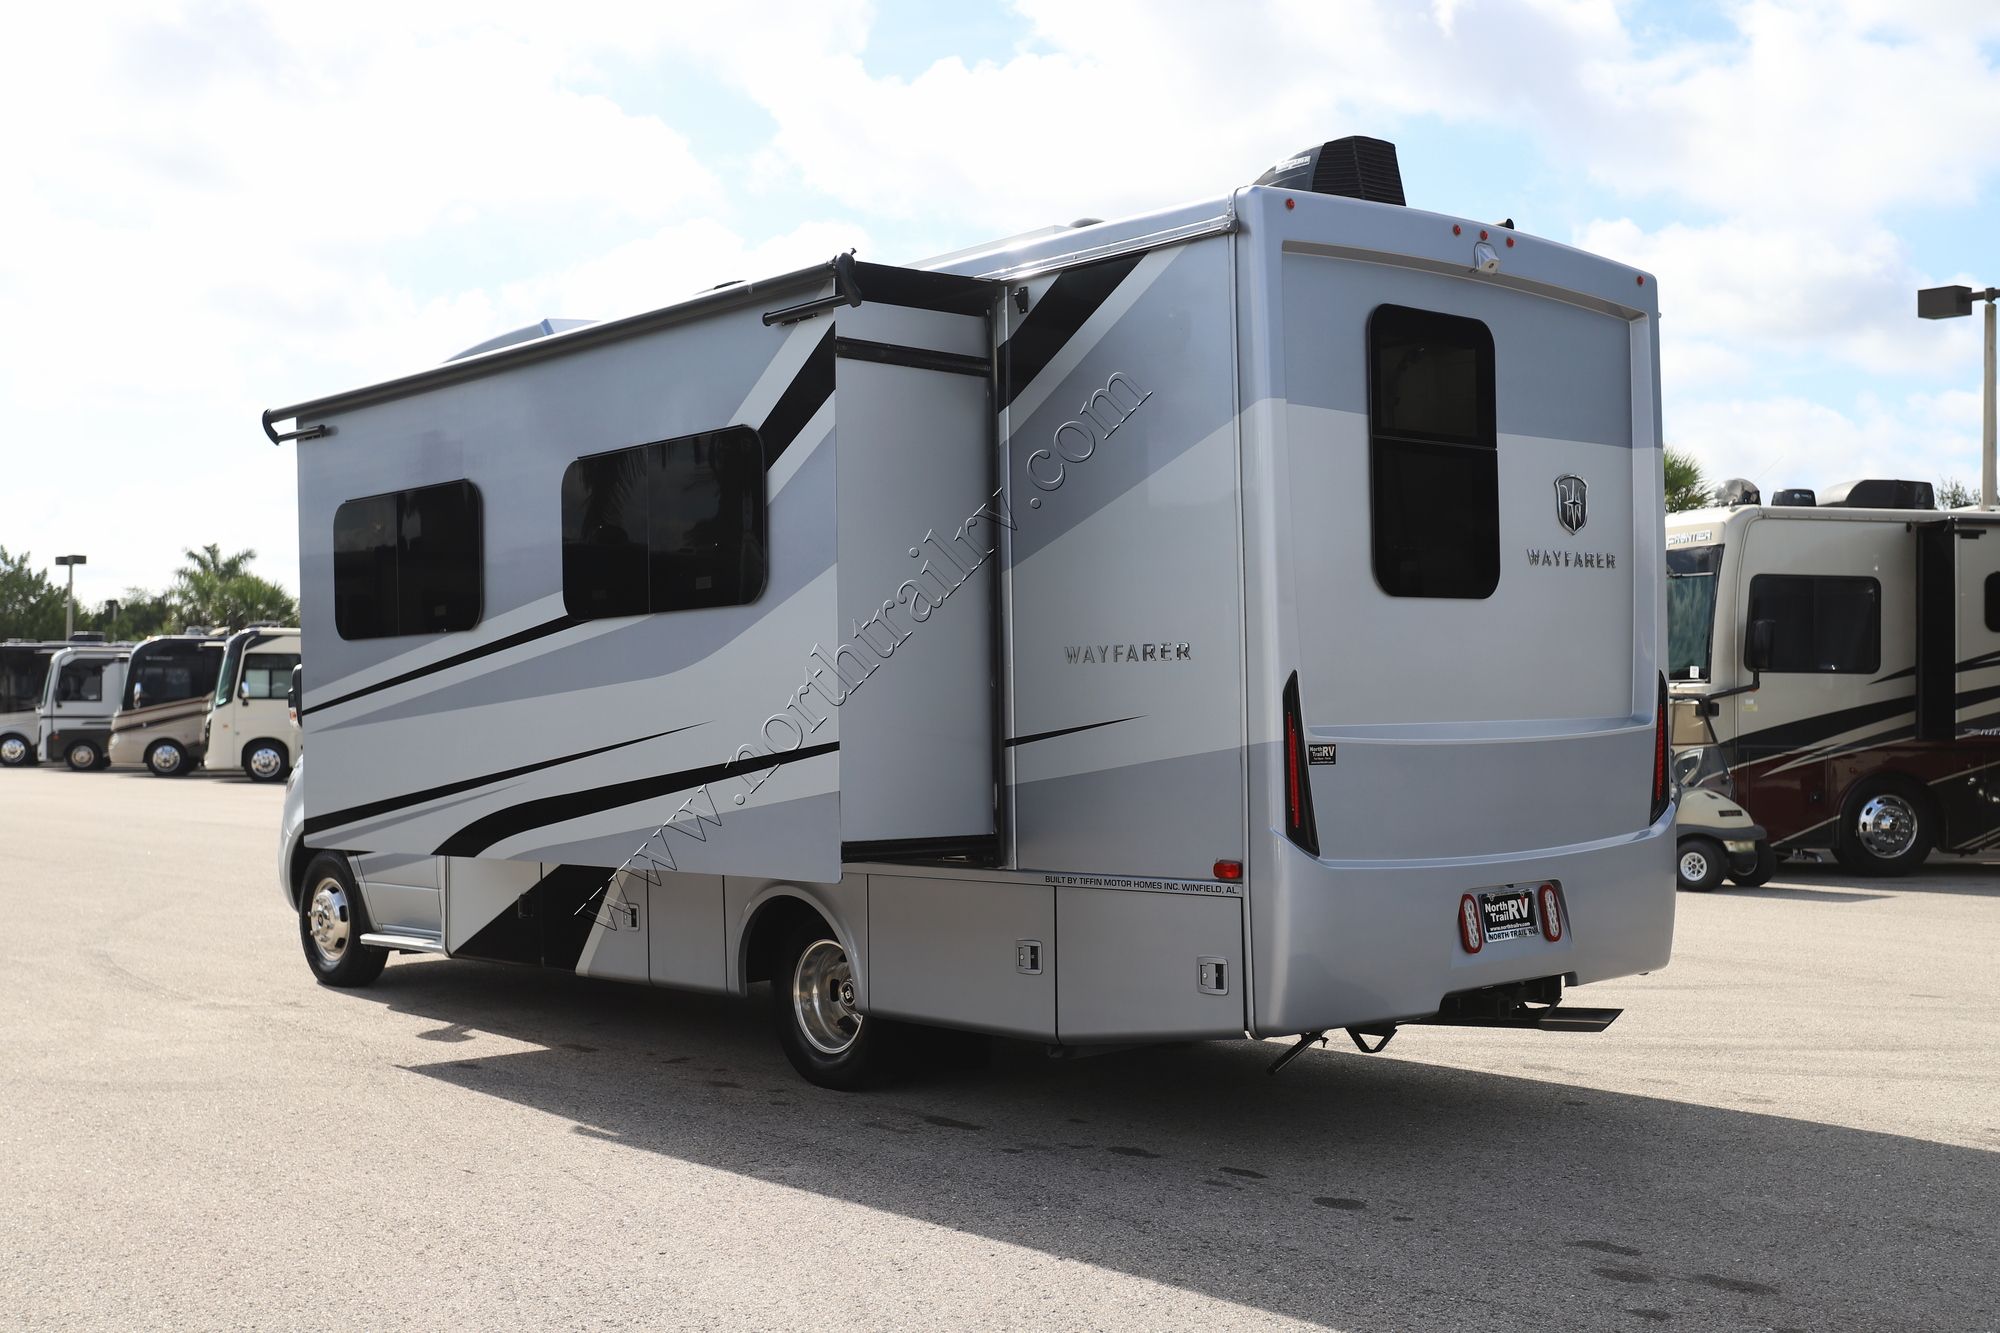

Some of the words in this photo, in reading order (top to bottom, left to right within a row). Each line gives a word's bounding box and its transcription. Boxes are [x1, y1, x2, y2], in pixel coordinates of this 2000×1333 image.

[1526, 548, 1616, 569] WAYFARER
[1064, 642, 1191, 664] WAYFARER
[1322, 746, 1335, 757] RV
[1045, 875, 1066, 884] BUILT
[1067, 876, 1078, 885] BY
[1079, 877, 1102, 886] TIFFIN
[1103, 879, 1132, 888] MOTOR
[1133, 880, 1163, 890] HOMES
[1163, 882, 1180, 891] INC.
[1181, 883, 1224, 894] WINFIELD,
[1226, 886, 1239, 895] AL.
[1484, 902, 1508, 913] North
[1507, 898, 1529, 920] RV
[1490, 912, 1509, 923] Trail
[1488, 930, 1510, 941] NORTH
[1510, 929, 1527, 938] TRAIL
